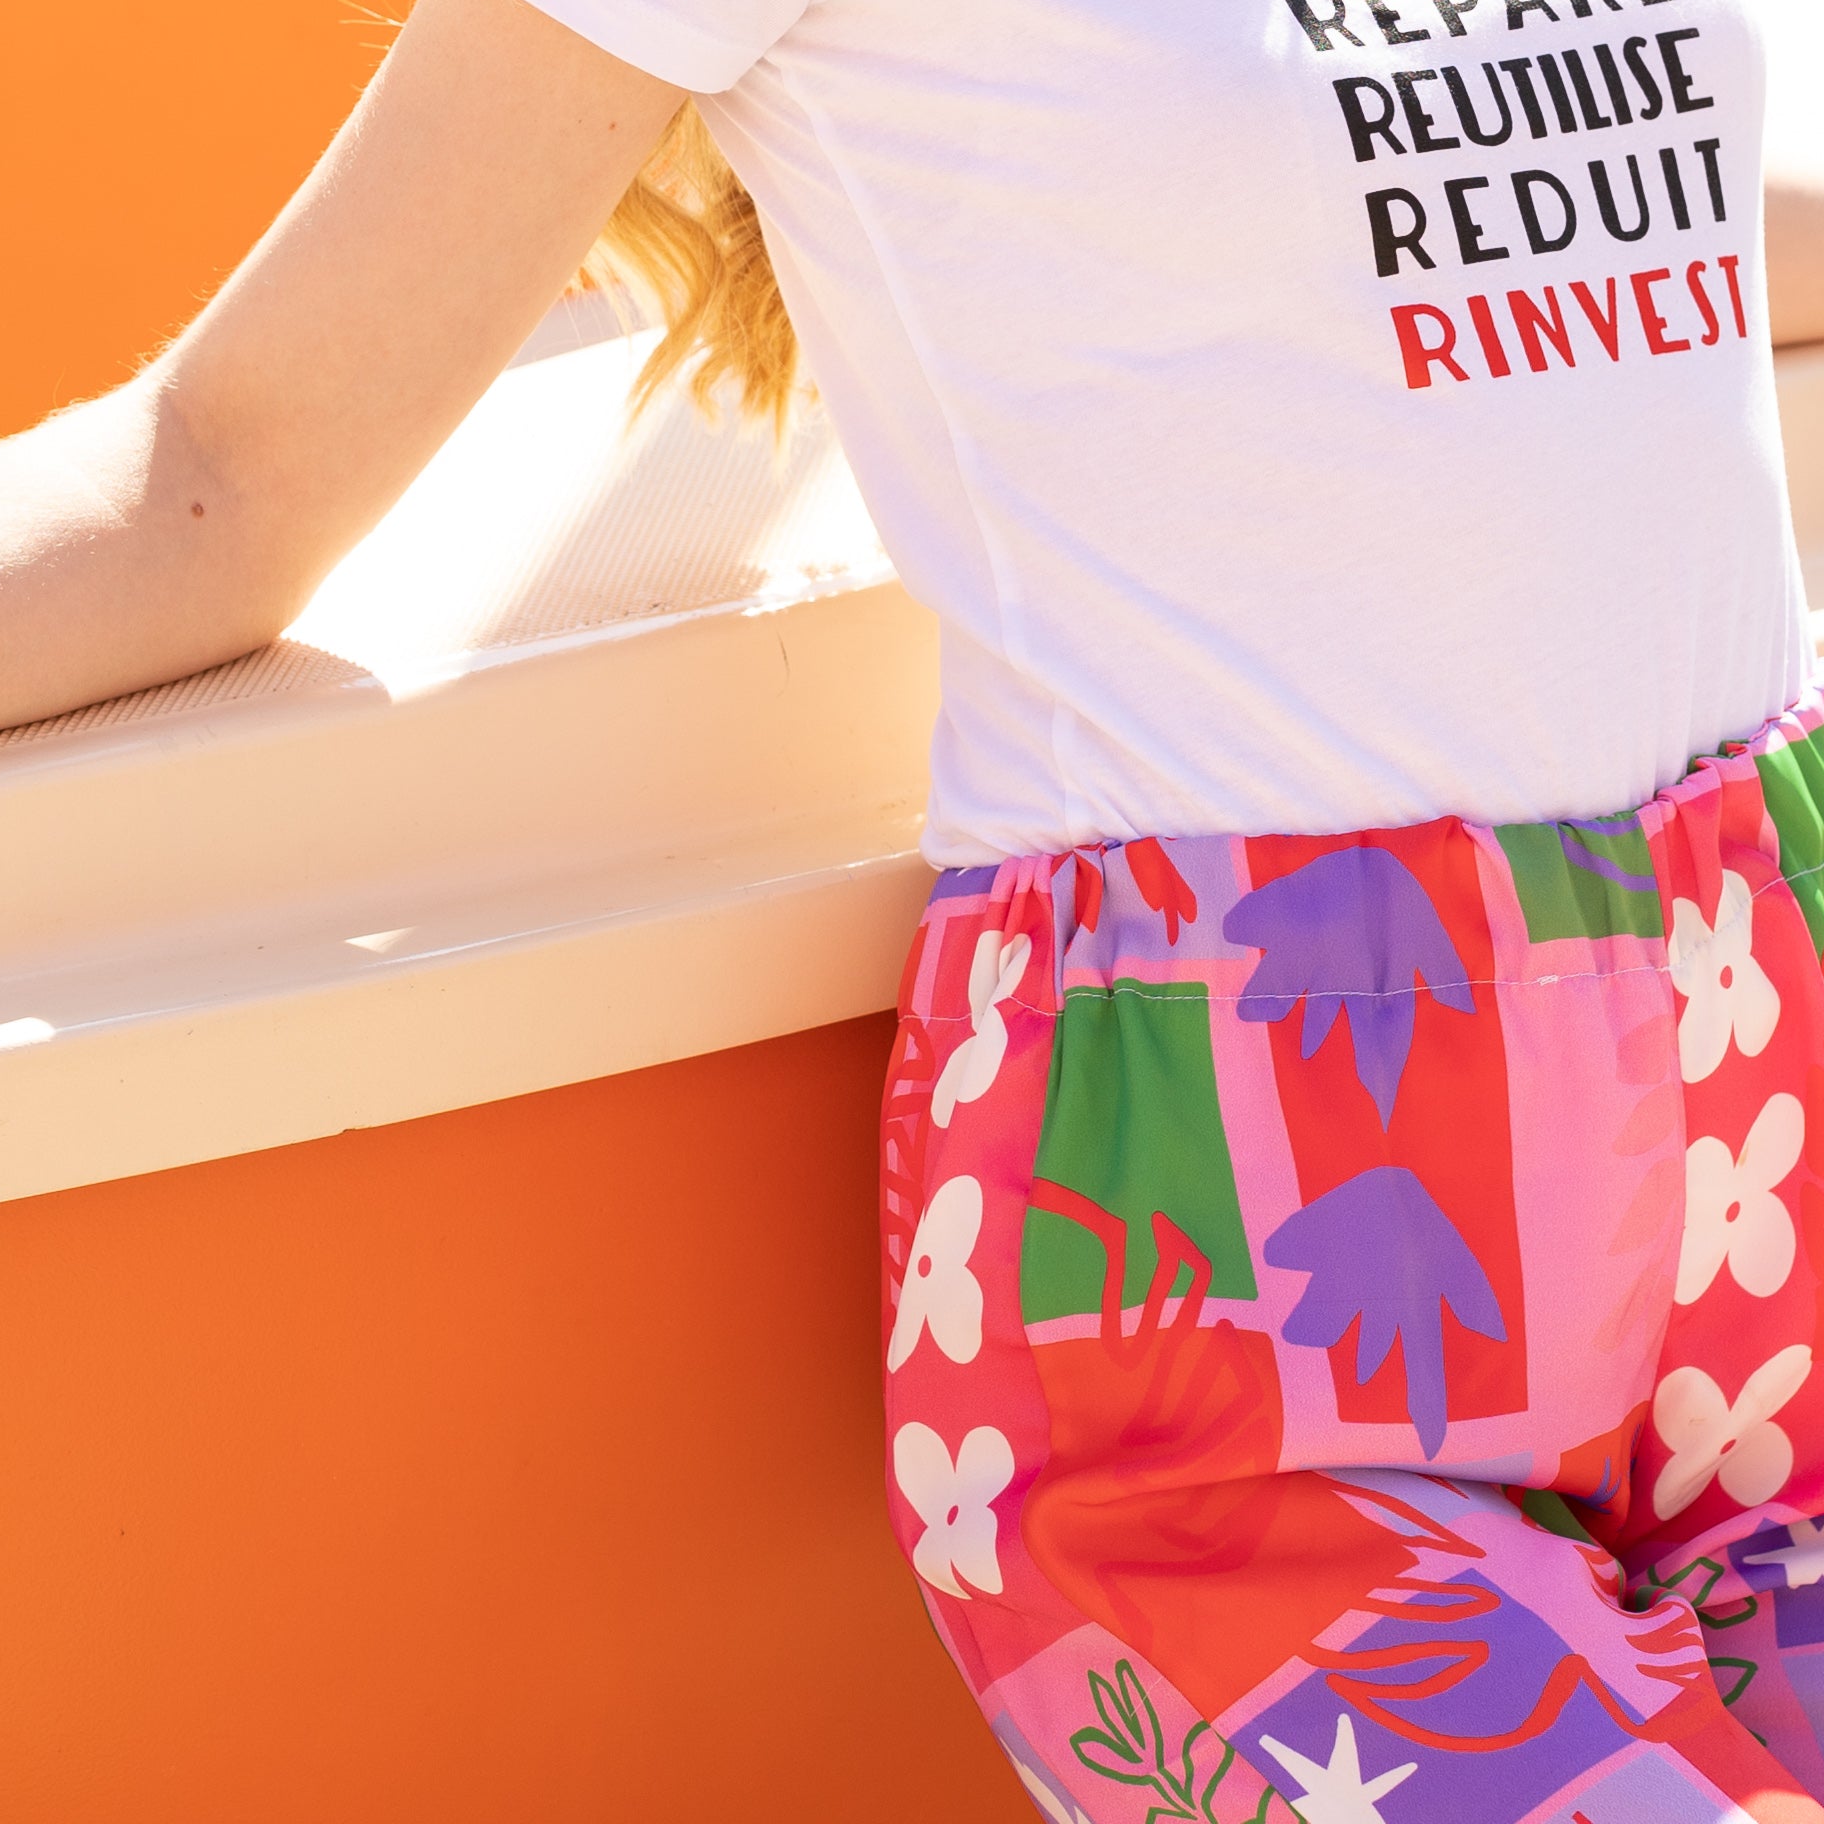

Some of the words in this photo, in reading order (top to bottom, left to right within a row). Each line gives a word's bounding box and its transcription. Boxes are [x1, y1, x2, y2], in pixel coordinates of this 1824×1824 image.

[1332, 28, 1714, 162] REUTILISE
[1364, 138, 1727, 277] REDUIT
[1390, 255, 1747, 388] RINVEST
